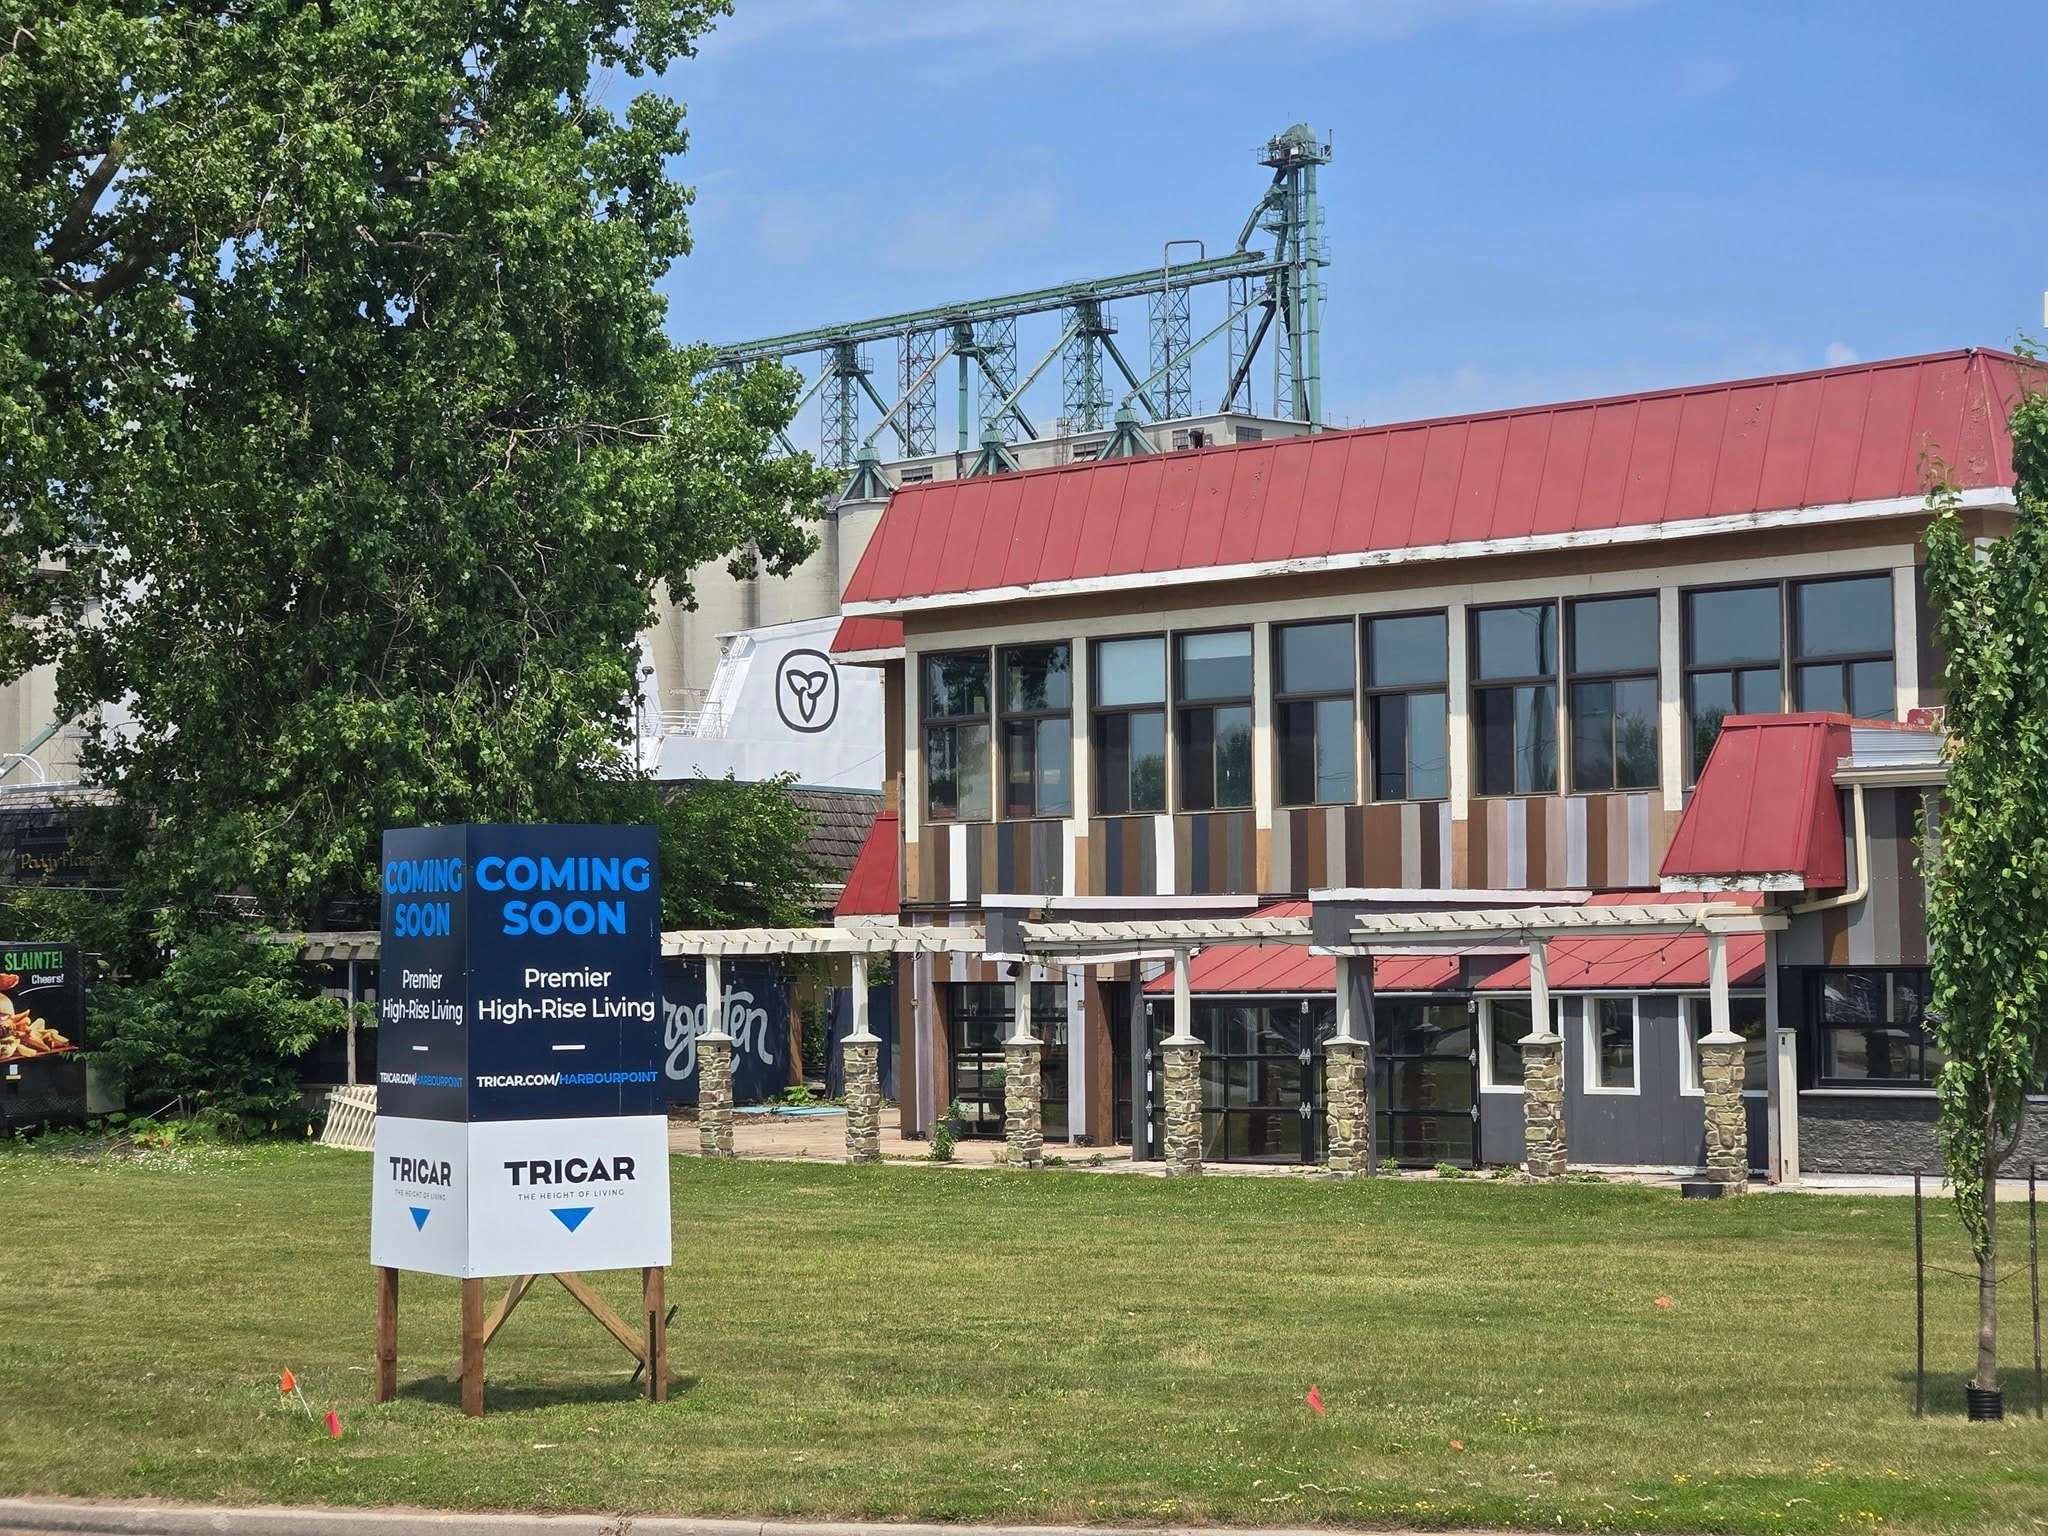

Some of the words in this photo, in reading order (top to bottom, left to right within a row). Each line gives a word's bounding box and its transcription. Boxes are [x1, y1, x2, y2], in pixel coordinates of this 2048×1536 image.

[384, 857, 463, 895] COMING
[475, 856, 650, 892] COMING
[395, 902, 450, 937] SOON
[502, 900, 626, 936] SOON
[31, 973, 65, 985] Cheers!
[402, 968, 442, 989] Premier
[524, 966, 612, 988] Premier
[382, 998, 430, 1023] High-Rise
[431, 1000, 464, 1025] Living
[478, 998, 587, 1025] High-Rise
[592, 996, 656, 1022] Living
[476, 1071, 658, 1088] TRICAR.COM/HARBOURPOINT
[389, 1156, 452, 1187] TRICAR
[503, 1156, 636, 1186] TRICAR
[518, 1193, 537, 1201] THE
[540, 1191, 575, 1200] HEIGHT
[578, 1190, 591, 1198] OF
[593, 1188, 626, 1198] LIVING
